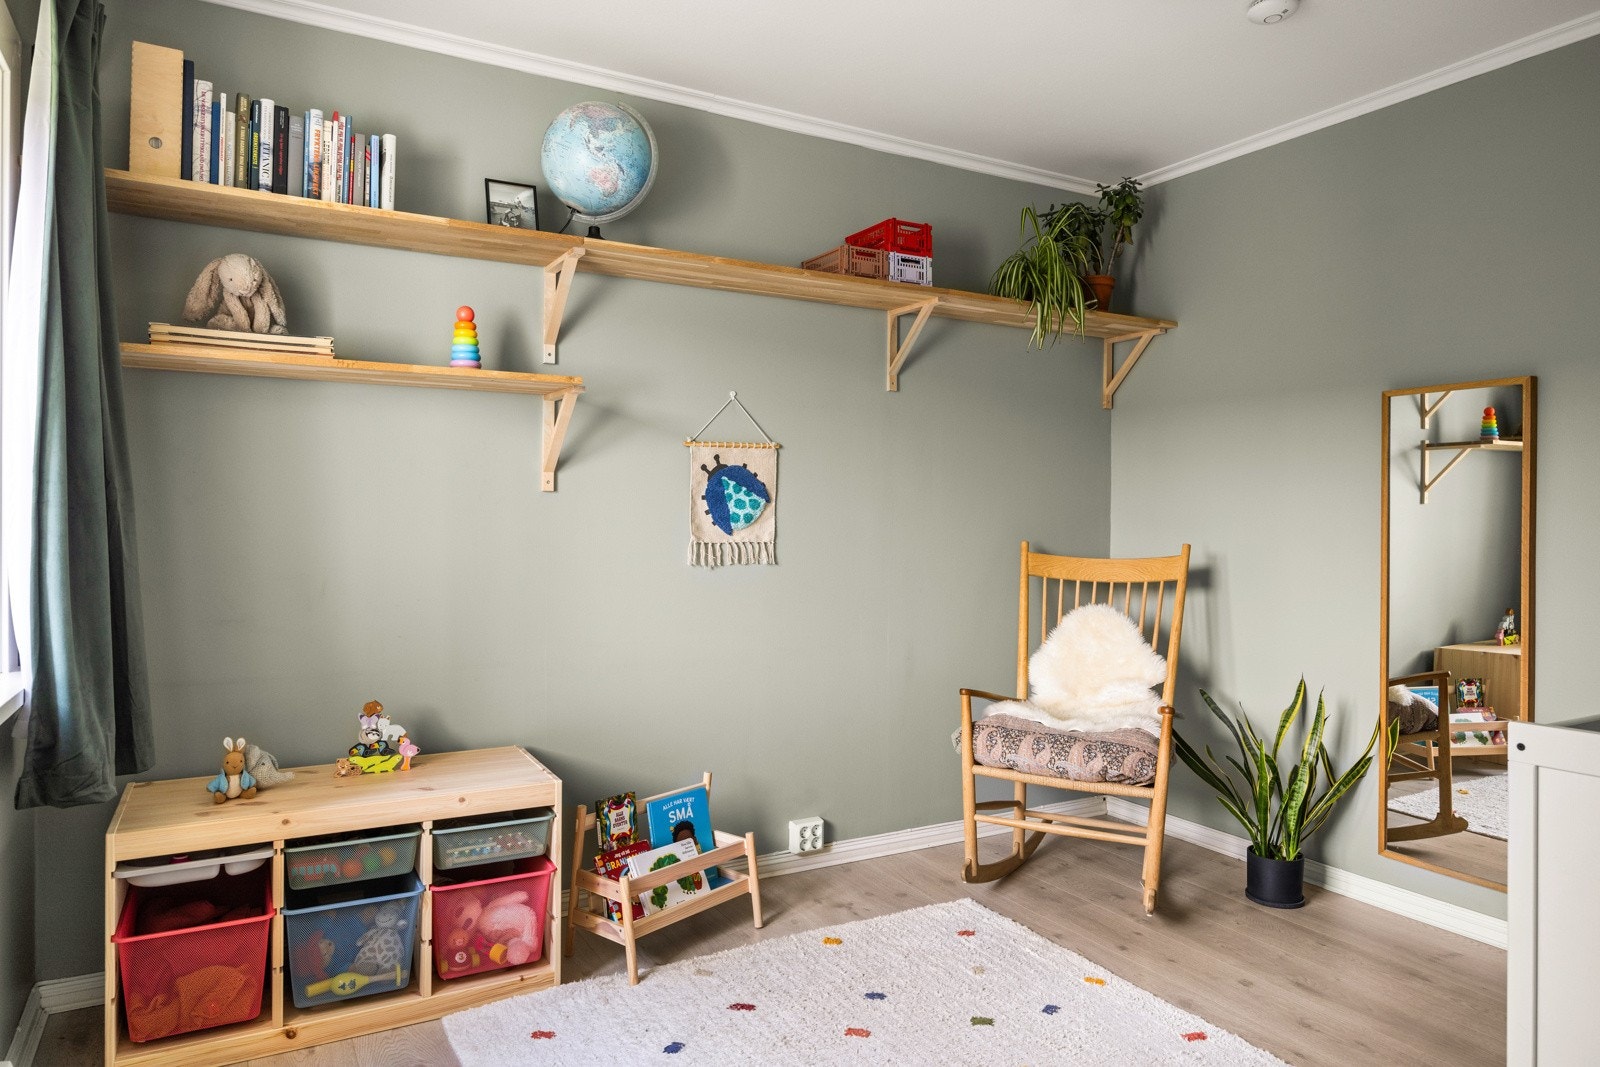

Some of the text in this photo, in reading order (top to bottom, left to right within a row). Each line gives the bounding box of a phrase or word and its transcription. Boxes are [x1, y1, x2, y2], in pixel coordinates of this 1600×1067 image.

[261, 141, 270, 178] TITANIC
[662, 801, 673, 811] ALLE
[673, 798, 683, 806] HAR
[668, 802, 694, 823] SMÅ
